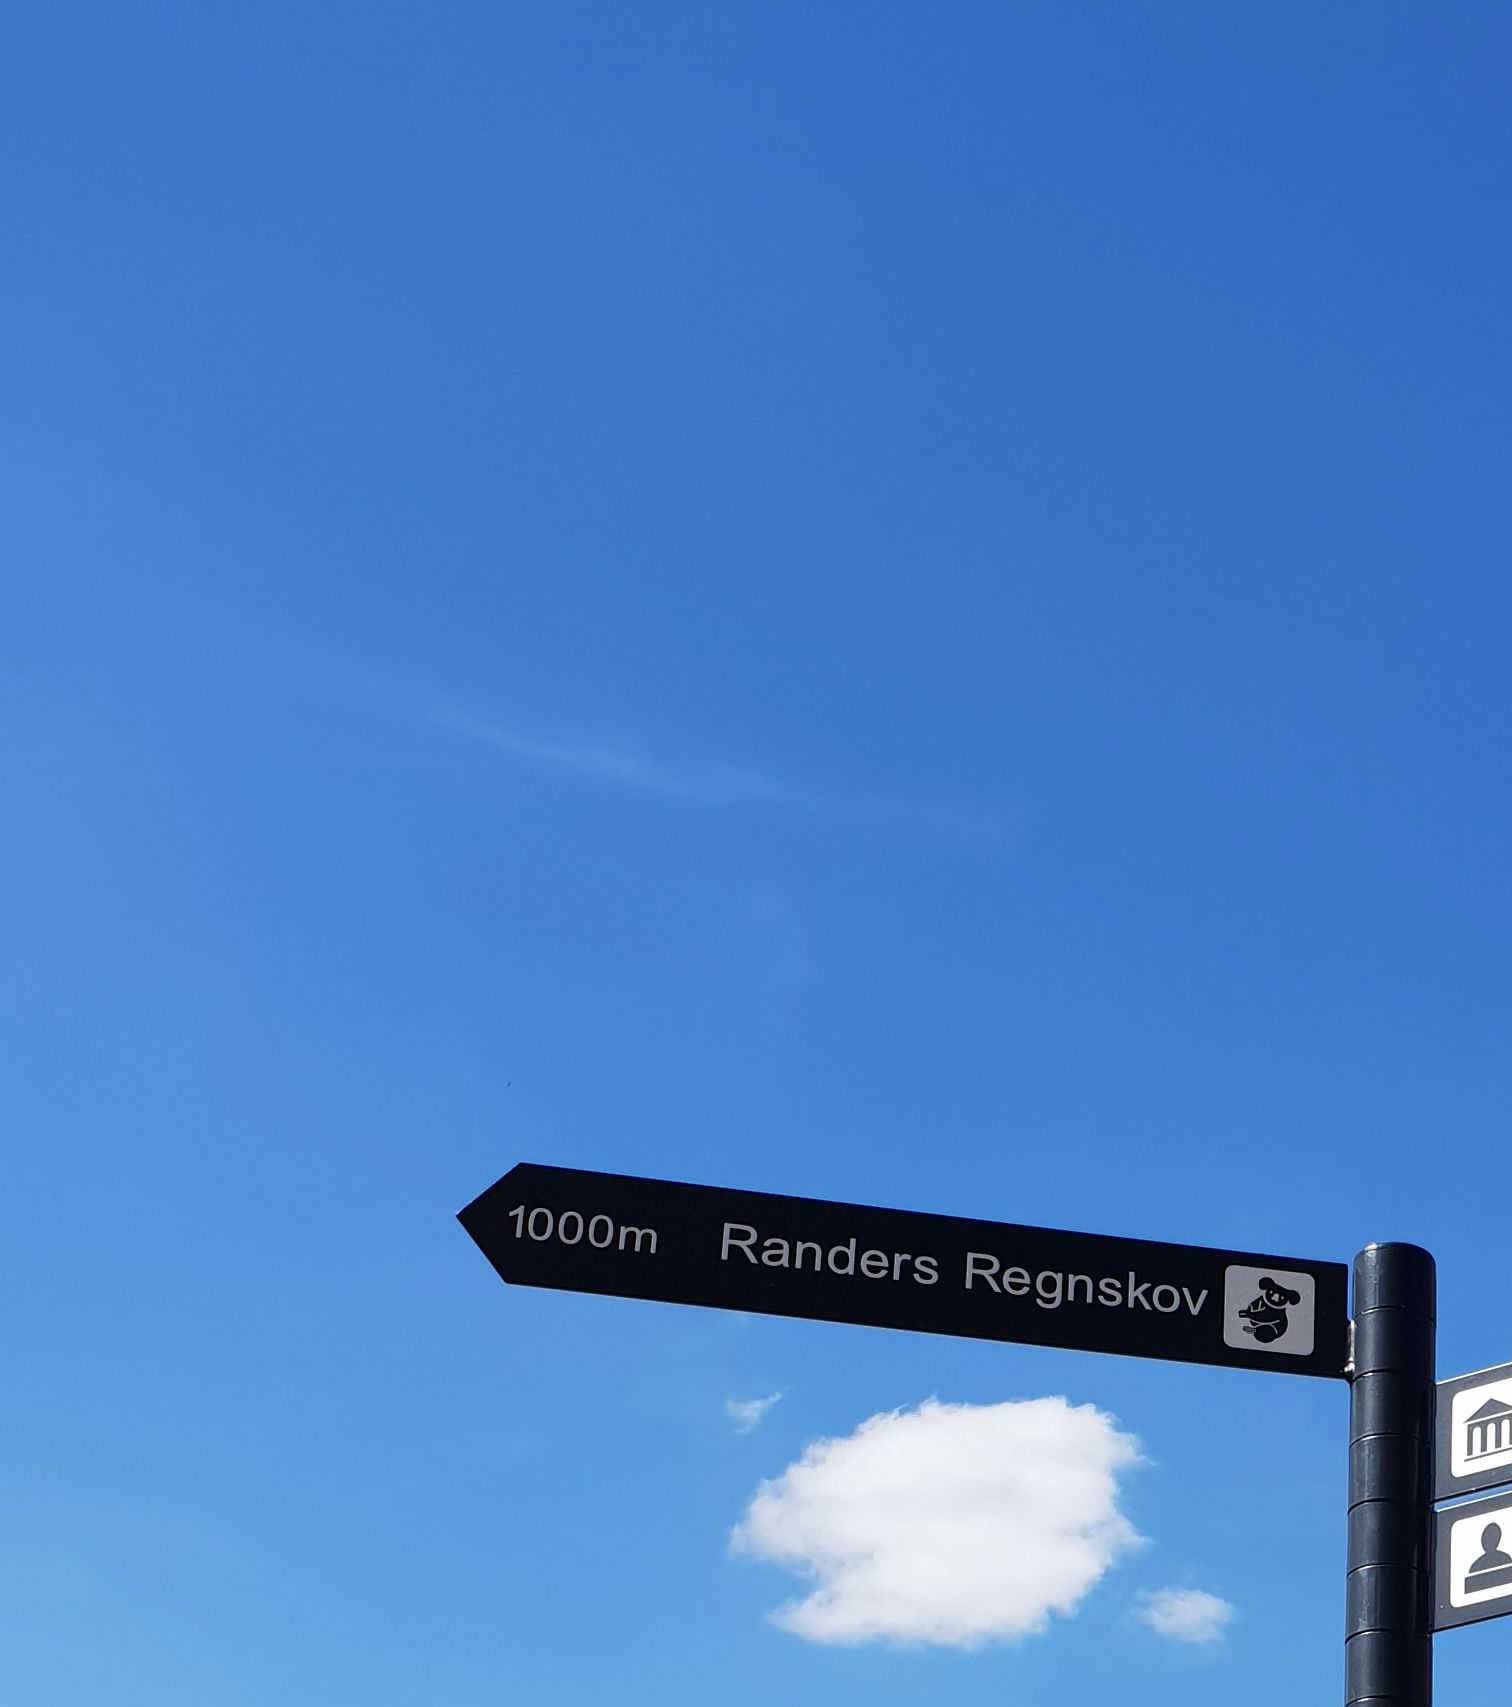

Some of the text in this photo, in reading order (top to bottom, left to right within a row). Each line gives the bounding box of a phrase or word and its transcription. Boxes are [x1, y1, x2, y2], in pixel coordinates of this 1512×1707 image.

[509, 1205, 1208, 1315] 1000m Randers Regnskov
